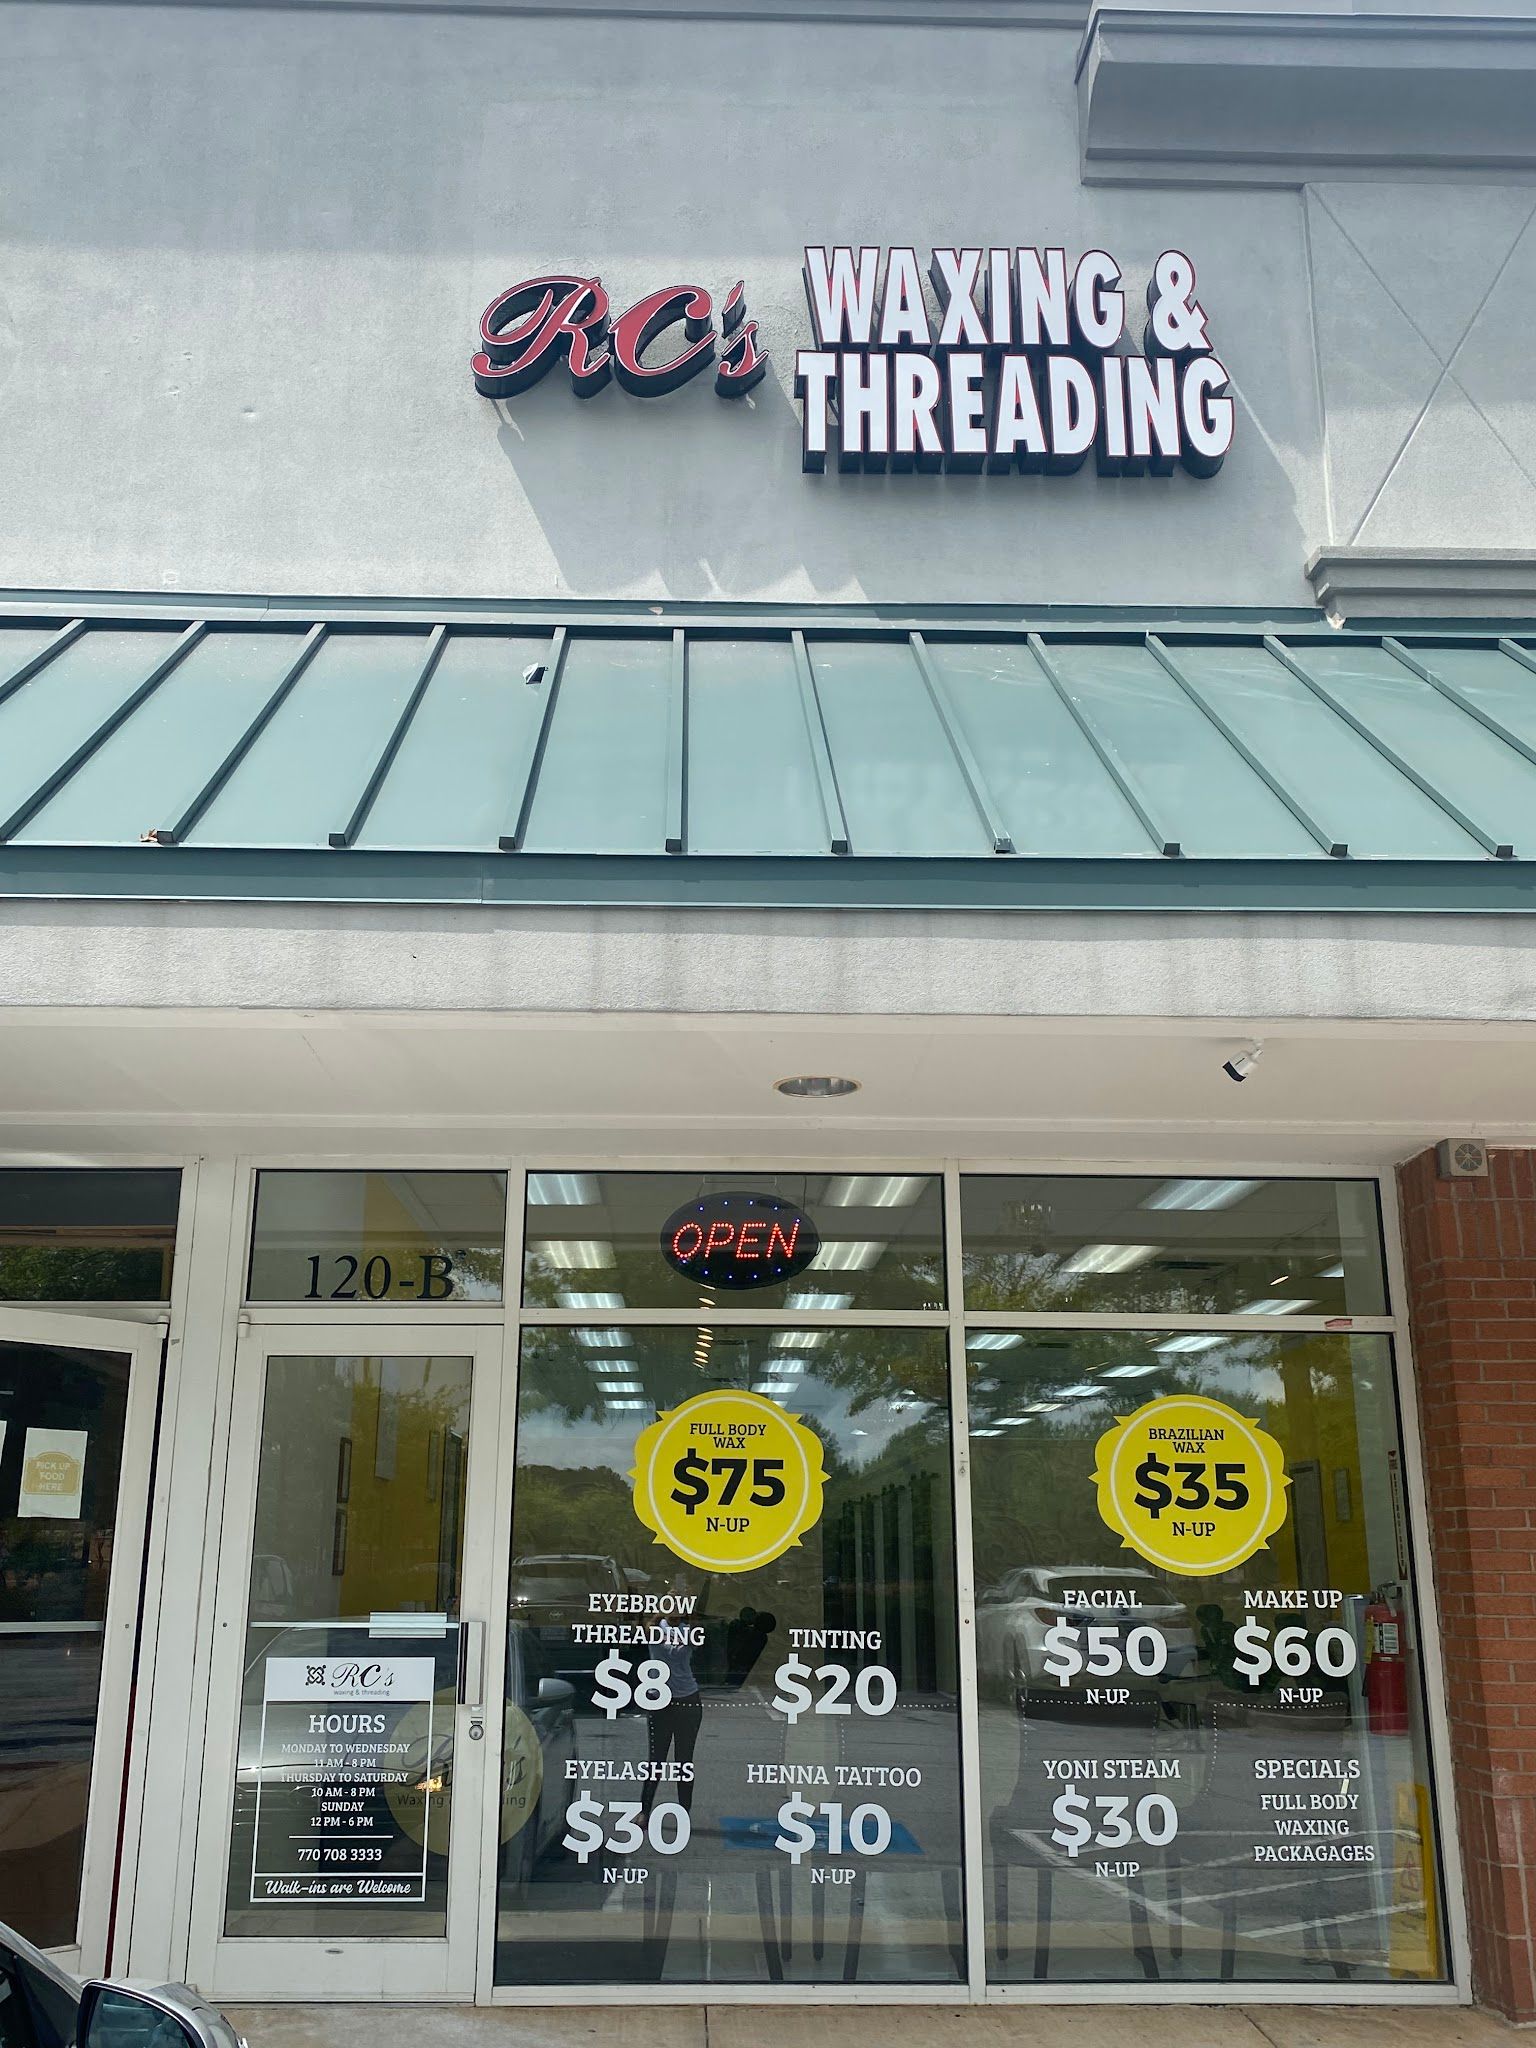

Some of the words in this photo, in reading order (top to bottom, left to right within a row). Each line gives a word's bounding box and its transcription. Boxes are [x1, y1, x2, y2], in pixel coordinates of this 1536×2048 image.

[803, 246, 1124, 348] WAXING
[1145, 249, 1212, 352] &
[471, 275, 770, 378] RC's
[797, 350, 1235, 458] THREADING
[672, 1222, 801, 1260] OPEN
[304, 1254, 454, 1300] 120-B
[689, 1422, 725, 1437] FULL
[727, 1422, 767, 1437] BODY
[1148, 1427, 1225, 1442] BRAZILIAN
[712, 1436, 746, 1450] WAX
[1172, 1441, 1206, 1455] WAX
[670, 1448, 786, 1515] $75
[1134, 1452, 1250, 1519] $35
[706, 1516, 751, 1533] N-UP
[1172, 1521, 1217, 1538] N-UP
[588, 1593, 697, 1616] EYEBROW
[1062, 1589, 1143, 1609] FACIAL
[1243, 1589, 1309, 1609] MAKE
[1312, 1589, 1343, 1609] UP
[572, 1624, 706, 1647] THREADING
[788, 1629, 882, 1650] TINTING
[1043, 1616, 1168, 1687] $50
[1232, 1616, 1357, 1686] $60
[590, 1649, 673, 1720] $8
[771, 1653, 898, 1724] $20
[1086, 1688, 1130, 1705] N-UP
[1279, 1687, 1324, 1704] N-UP
[308, 1714, 386, 1734] HOURS
[281, 1743, 328, 1753] MONDAY
[329, 1743, 343, 1753] TO
[345, 1743, 410, 1753] WEDNESDAY
[325, 1758, 343, 1768] AM
[351, 1758, 358, 1768] 8
[360, 1758, 376, 1768] PM
[565, 1759, 694, 1782] EYELASHES
[1043, 1759, 1098, 1779] YONI
[1104, 1759, 1181, 1779] STEAM
[1254, 1759, 1361, 1779] SPECIALS
[280, 1772, 336, 1783] THURSDAY
[338, 1772, 352, 1783] TO
[354, 1772, 408, 1783] SATURDAY
[747, 1764, 829, 1785] HENNA
[833, 1765, 922, 1786] TATTOO
[311, 1787, 323, 1797] 10
[325, 1787, 343, 1797] AM
[351, 1787, 357, 1797] 8
[359, 1787, 375, 1797] PM
[1261, 1794, 1306, 1810] FULL
[1310, 1794, 1359, 1810] BODY
[321, 1801, 364, 1812] SUNDAY
[311, 1816, 322, 1827] 12
[324, 1816, 340, 1827] PM
[348, 1816, 355, 1827] 6
[357, 1816, 374, 1827] PM
[562, 1790, 690, 1863] $30
[774, 1792, 892, 1864] $10
[1051, 1784, 1179, 1857] $30
[1275, 1820, 1350, 1836] WAXING
[298, 1849, 320, 1861] 770
[324, 1849, 347, 1861] 708
[350, 1849, 382, 1861] 3333
[1254, 1845, 1375, 1862] PACKAGAGES
[602, 1868, 648, 1884] N-UP
[810, 1868, 855, 1885] N-UP
[1095, 1861, 1140, 1878] N-UP
[265, 1880, 327, 1894] Walk-ins
[329, 1883, 353, 1894] are
[356, 1879, 411, 1894] Welcome
